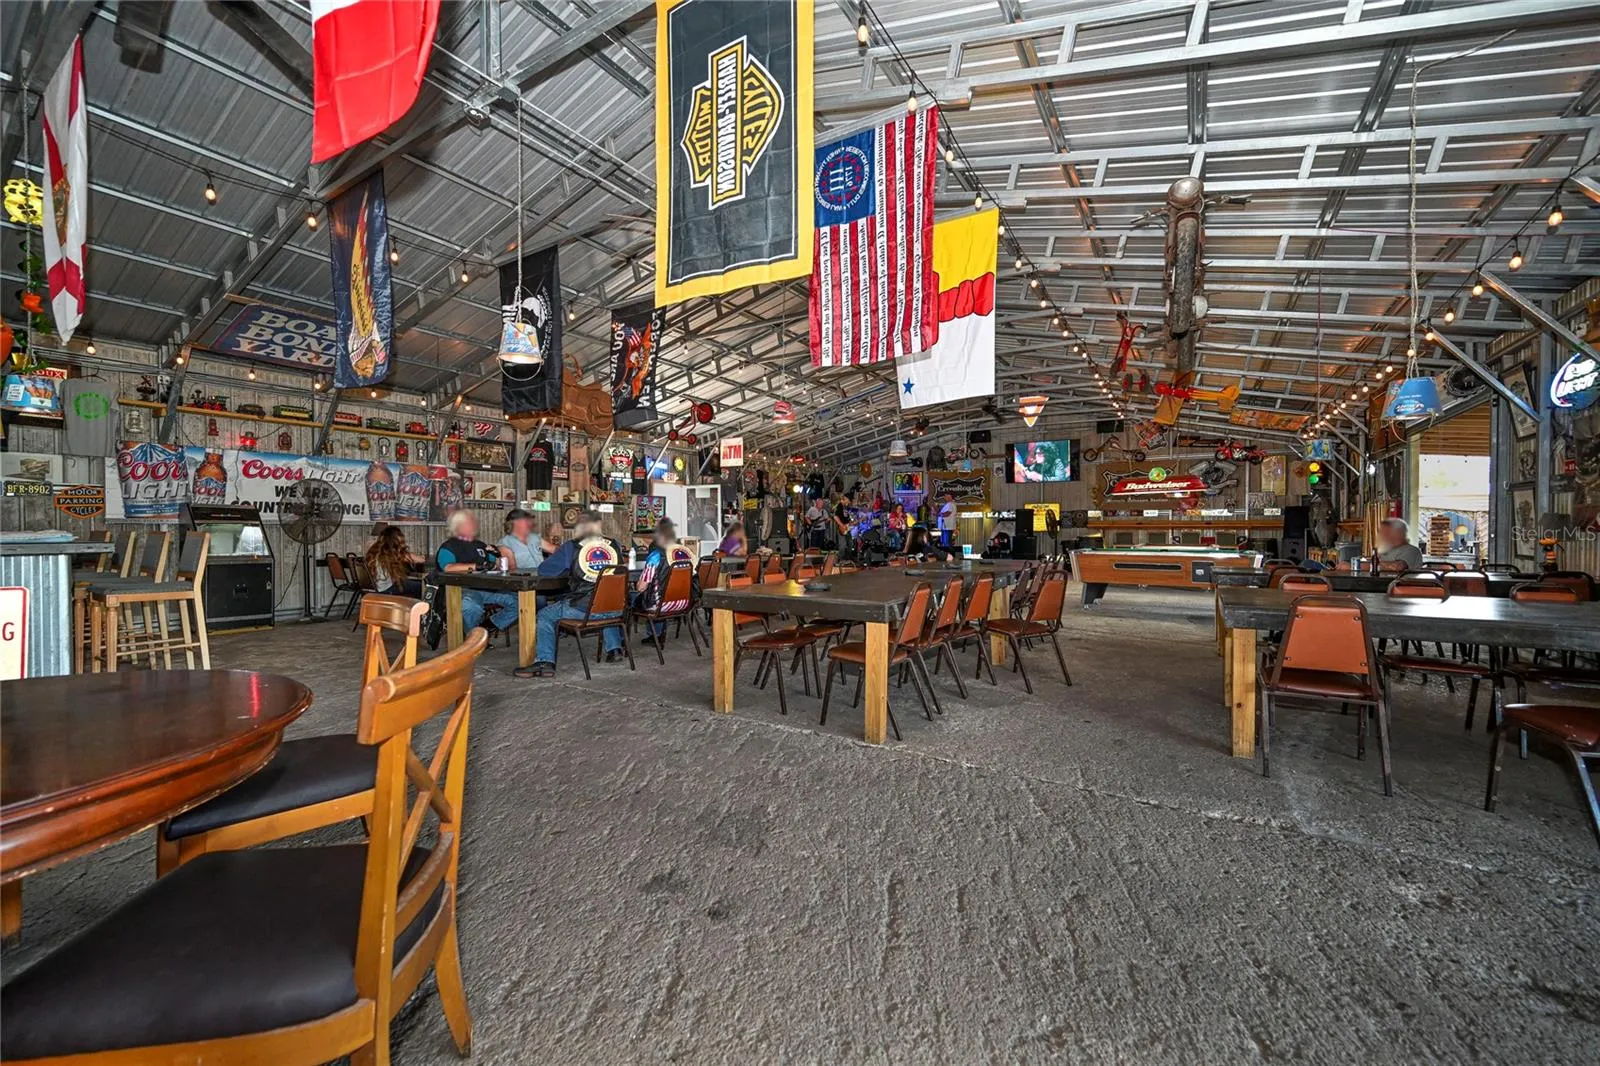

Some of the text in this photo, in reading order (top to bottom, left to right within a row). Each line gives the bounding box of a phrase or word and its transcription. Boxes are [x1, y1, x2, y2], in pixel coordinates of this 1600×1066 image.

[722, 445, 742, 460] ATM
[242, 458, 359, 484] Coors LIGHT
[1124, 481, 1190, 490] Budweiser
[68, 488, 98, 496] MOTOR
[274, 485, 329, 499] WE ARE
[70, 506, 96, 515] CYCLES
